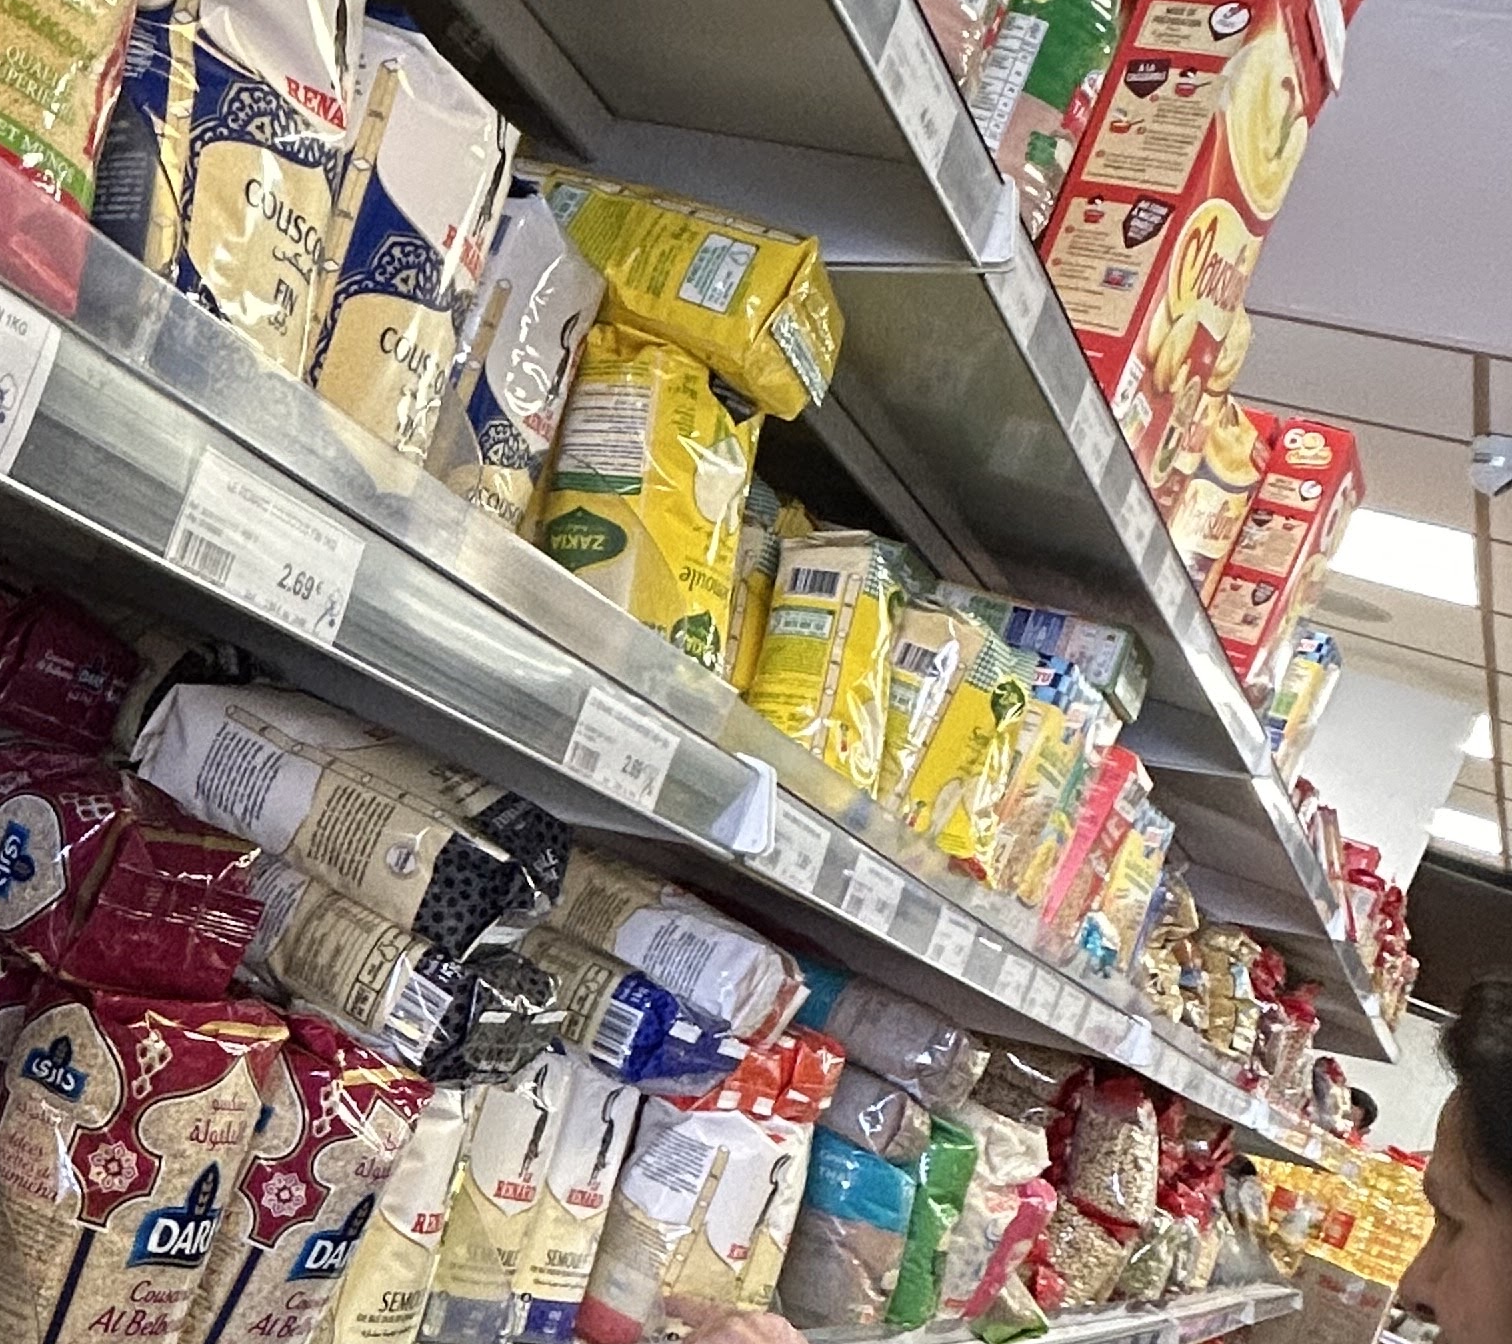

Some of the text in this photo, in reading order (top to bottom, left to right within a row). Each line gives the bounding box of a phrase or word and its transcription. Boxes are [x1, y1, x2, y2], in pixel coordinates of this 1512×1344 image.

[284, 74, 348, 131] RENA
[273, 277, 297, 318] FIN
[6, 311, 29, 337] 1KG
[549, 533, 606, 553] ZAKIA
[276, 562, 316, 601] 2.69
[377, 1290, 421, 1313] SEMO
[87, 1306, 119, 1336] Al
